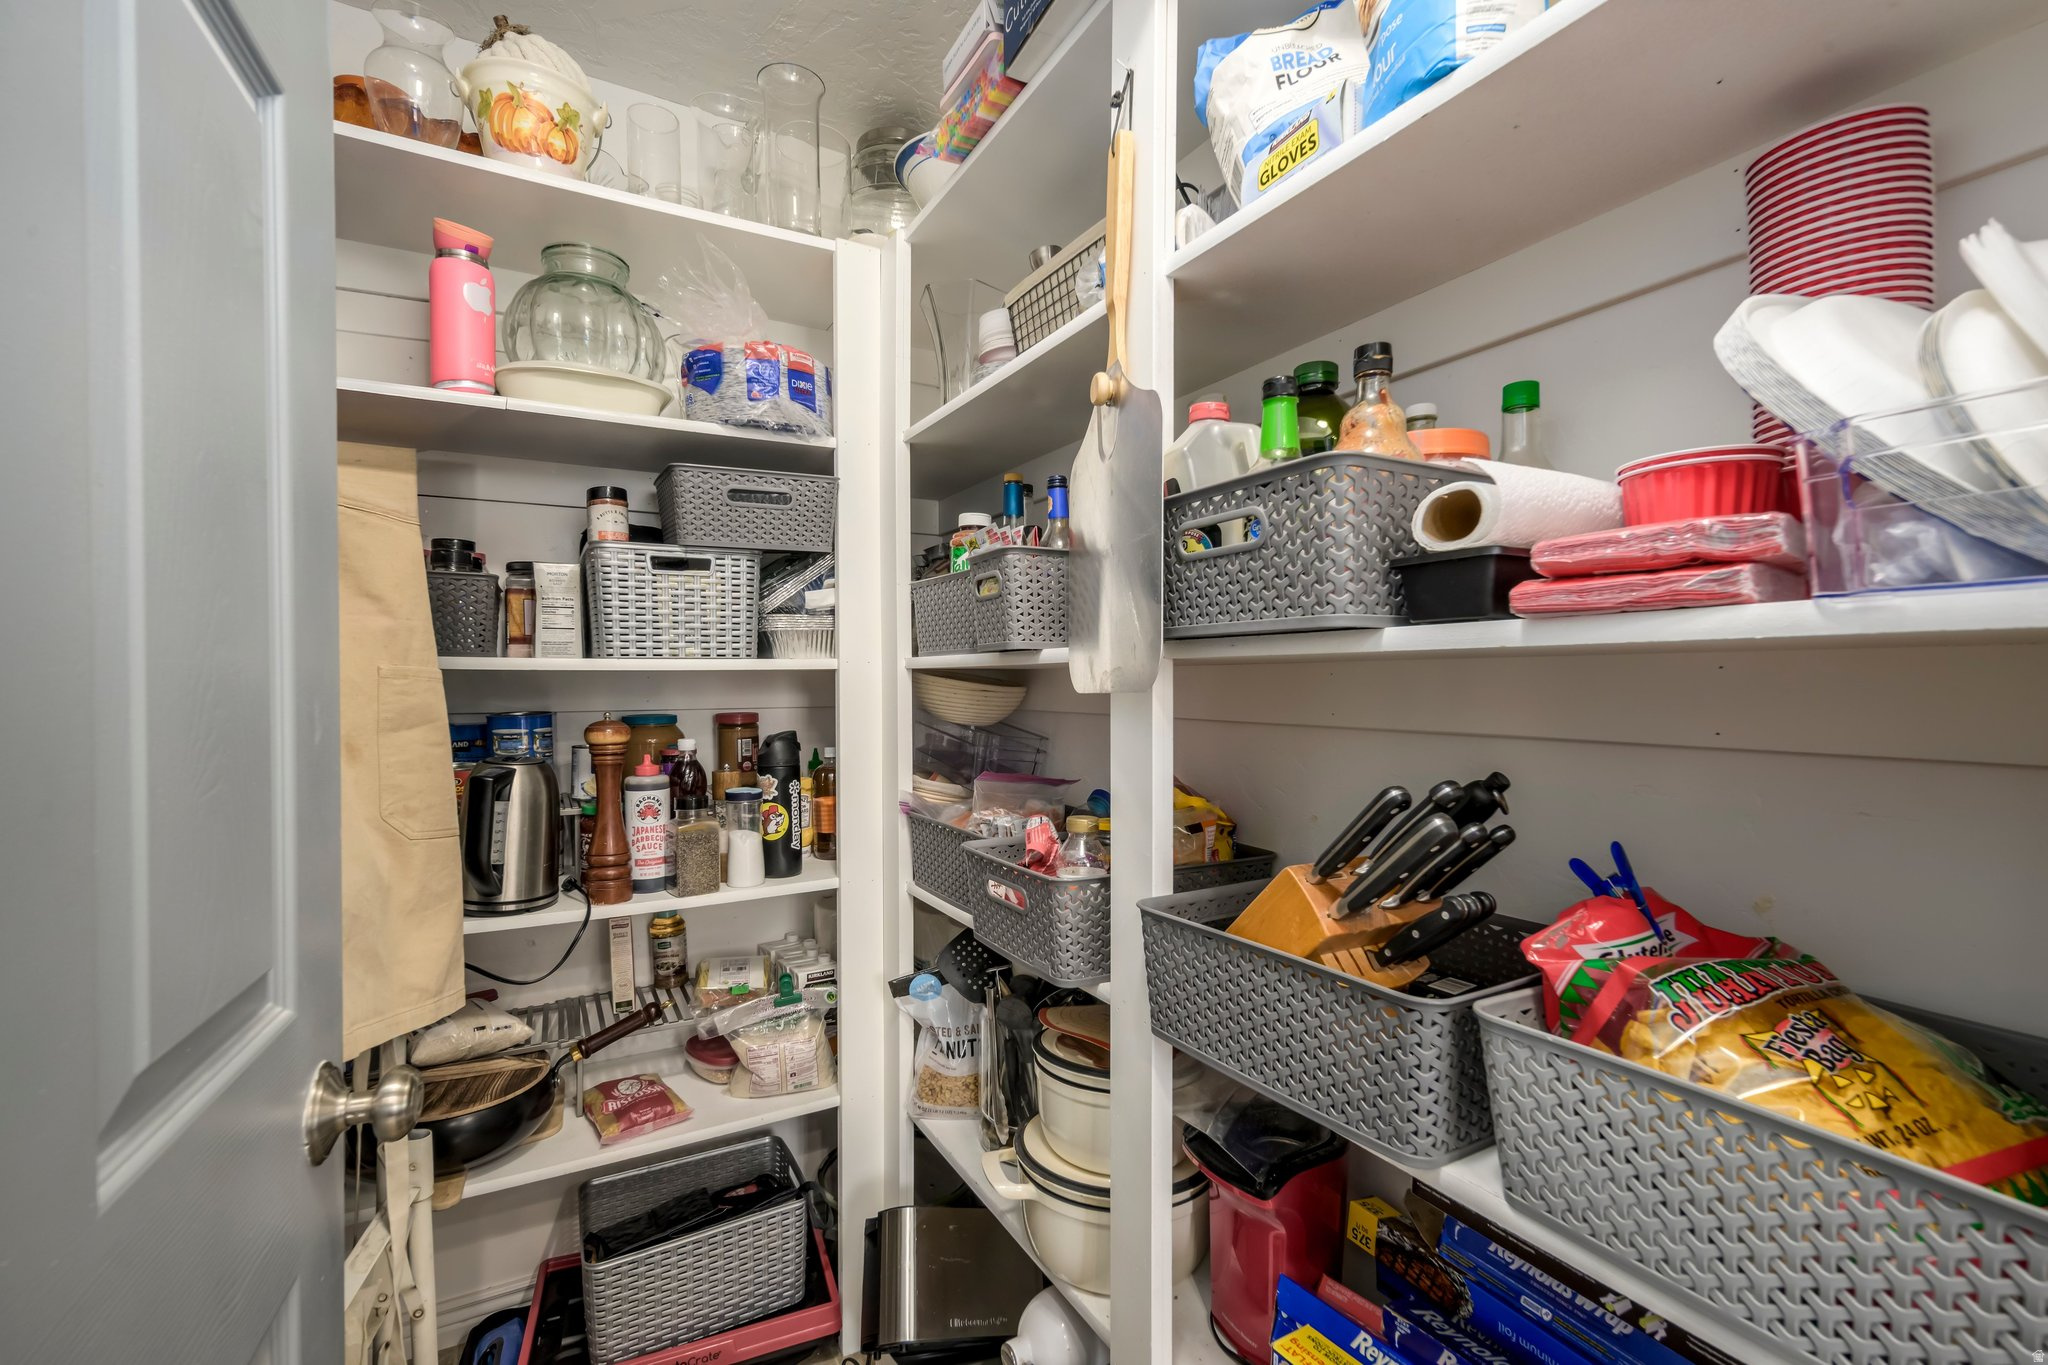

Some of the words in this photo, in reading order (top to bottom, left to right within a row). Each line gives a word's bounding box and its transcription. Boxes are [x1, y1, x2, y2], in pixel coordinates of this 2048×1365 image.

[1270, 46, 1333, 72] BREAD
[1275, 52, 1342, 91] FLOUR
[1264, 143, 1292, 169] NITRILE
[1291, 125, 1312, 149] EXAM
[1259, 132, 1318, 187] GLOVES
[452, 741, 469, 749] AND
[635, 842, 664, 853] SAUCE
[807, 969, 834, 980] KIRKLAND
[955, 1026, 962, 1037] &
[1764, 1010, 1829, 1060] Fiesta
[1802, 1034, 1866, 1073] Bag
[607, 1083, 666, 1113] RISCOSSA
[1893, 1122, 1920, 1144] 24
[1352, 1227, 1371, 1250] 37.5
[1498, 1321, 1517, 1343] foil
